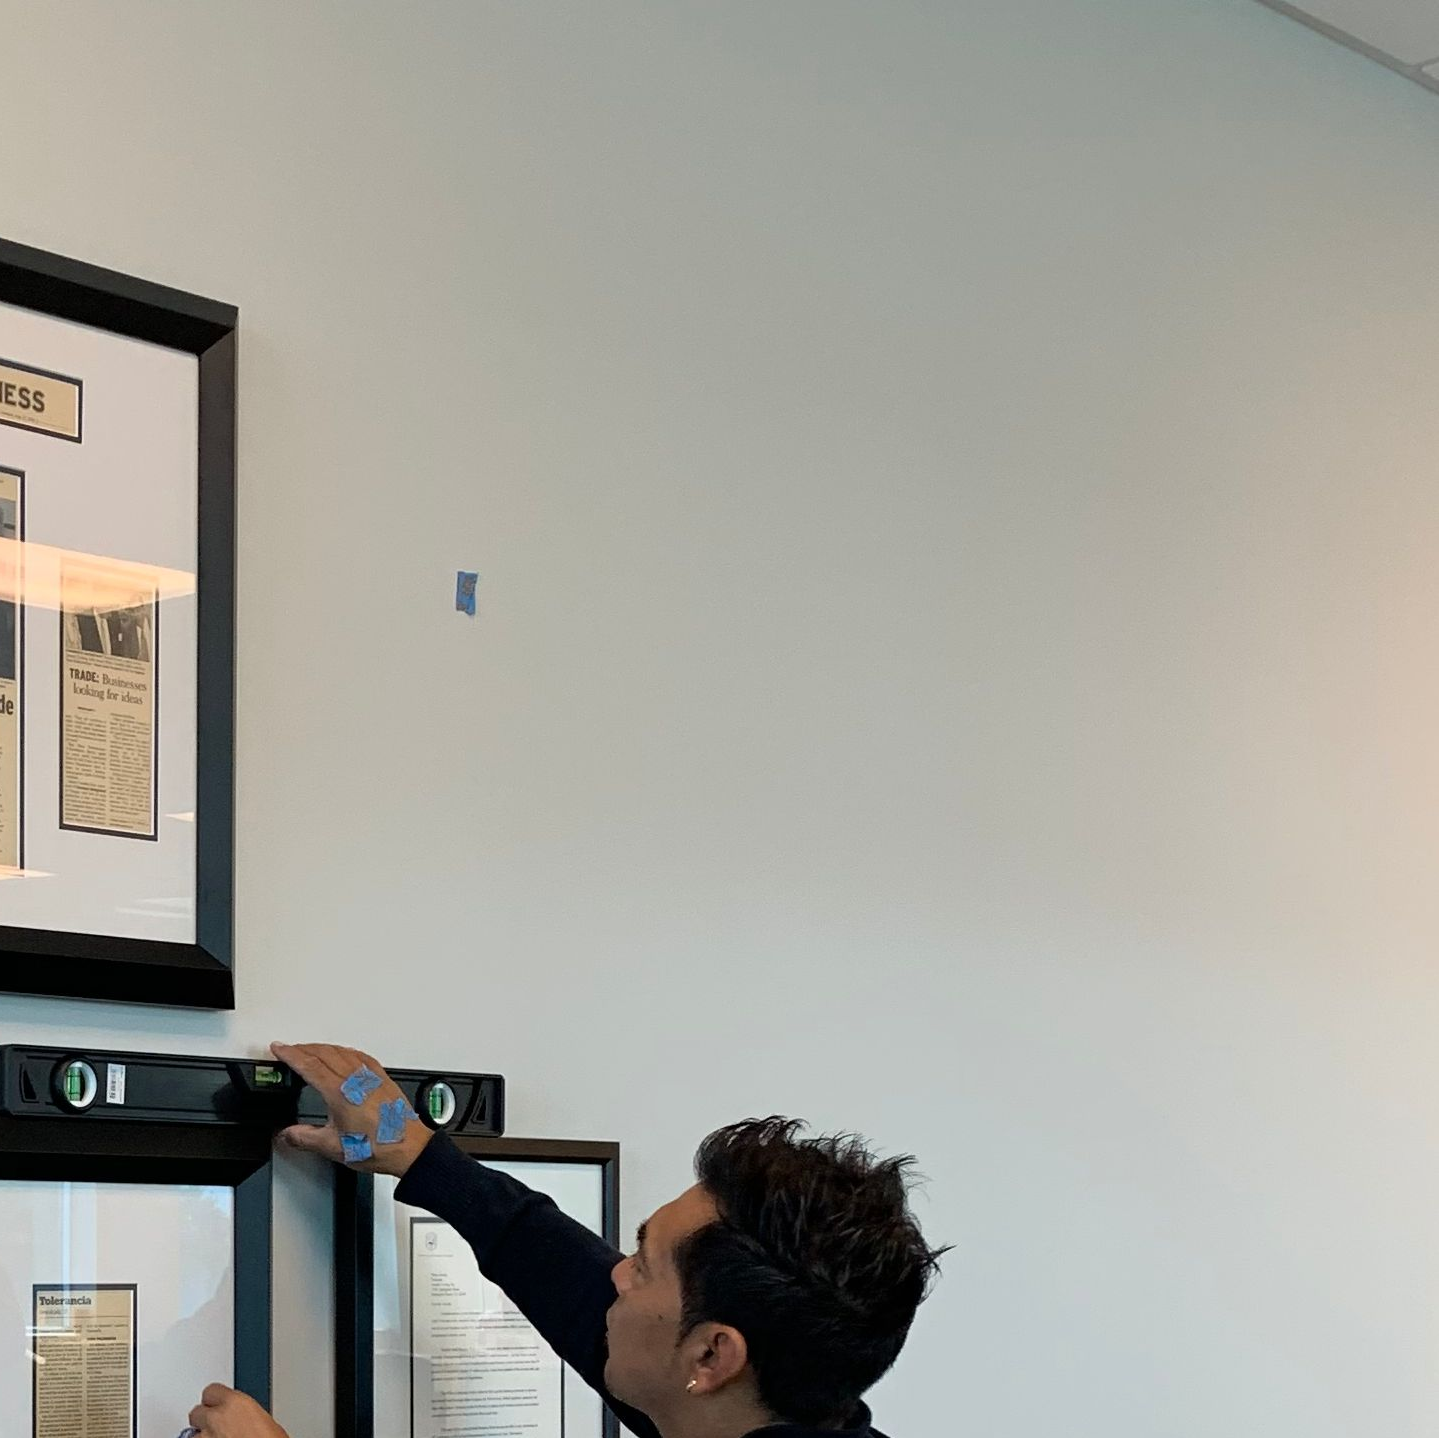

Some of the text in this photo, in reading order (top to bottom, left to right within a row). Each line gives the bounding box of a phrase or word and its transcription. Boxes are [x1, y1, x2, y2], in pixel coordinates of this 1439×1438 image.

[69, 668, 147, 691] TRADE: Businesses
[73, 682, 143, 705] looking for ideas
[39, 1295, 92, 1306] Tolerancia
